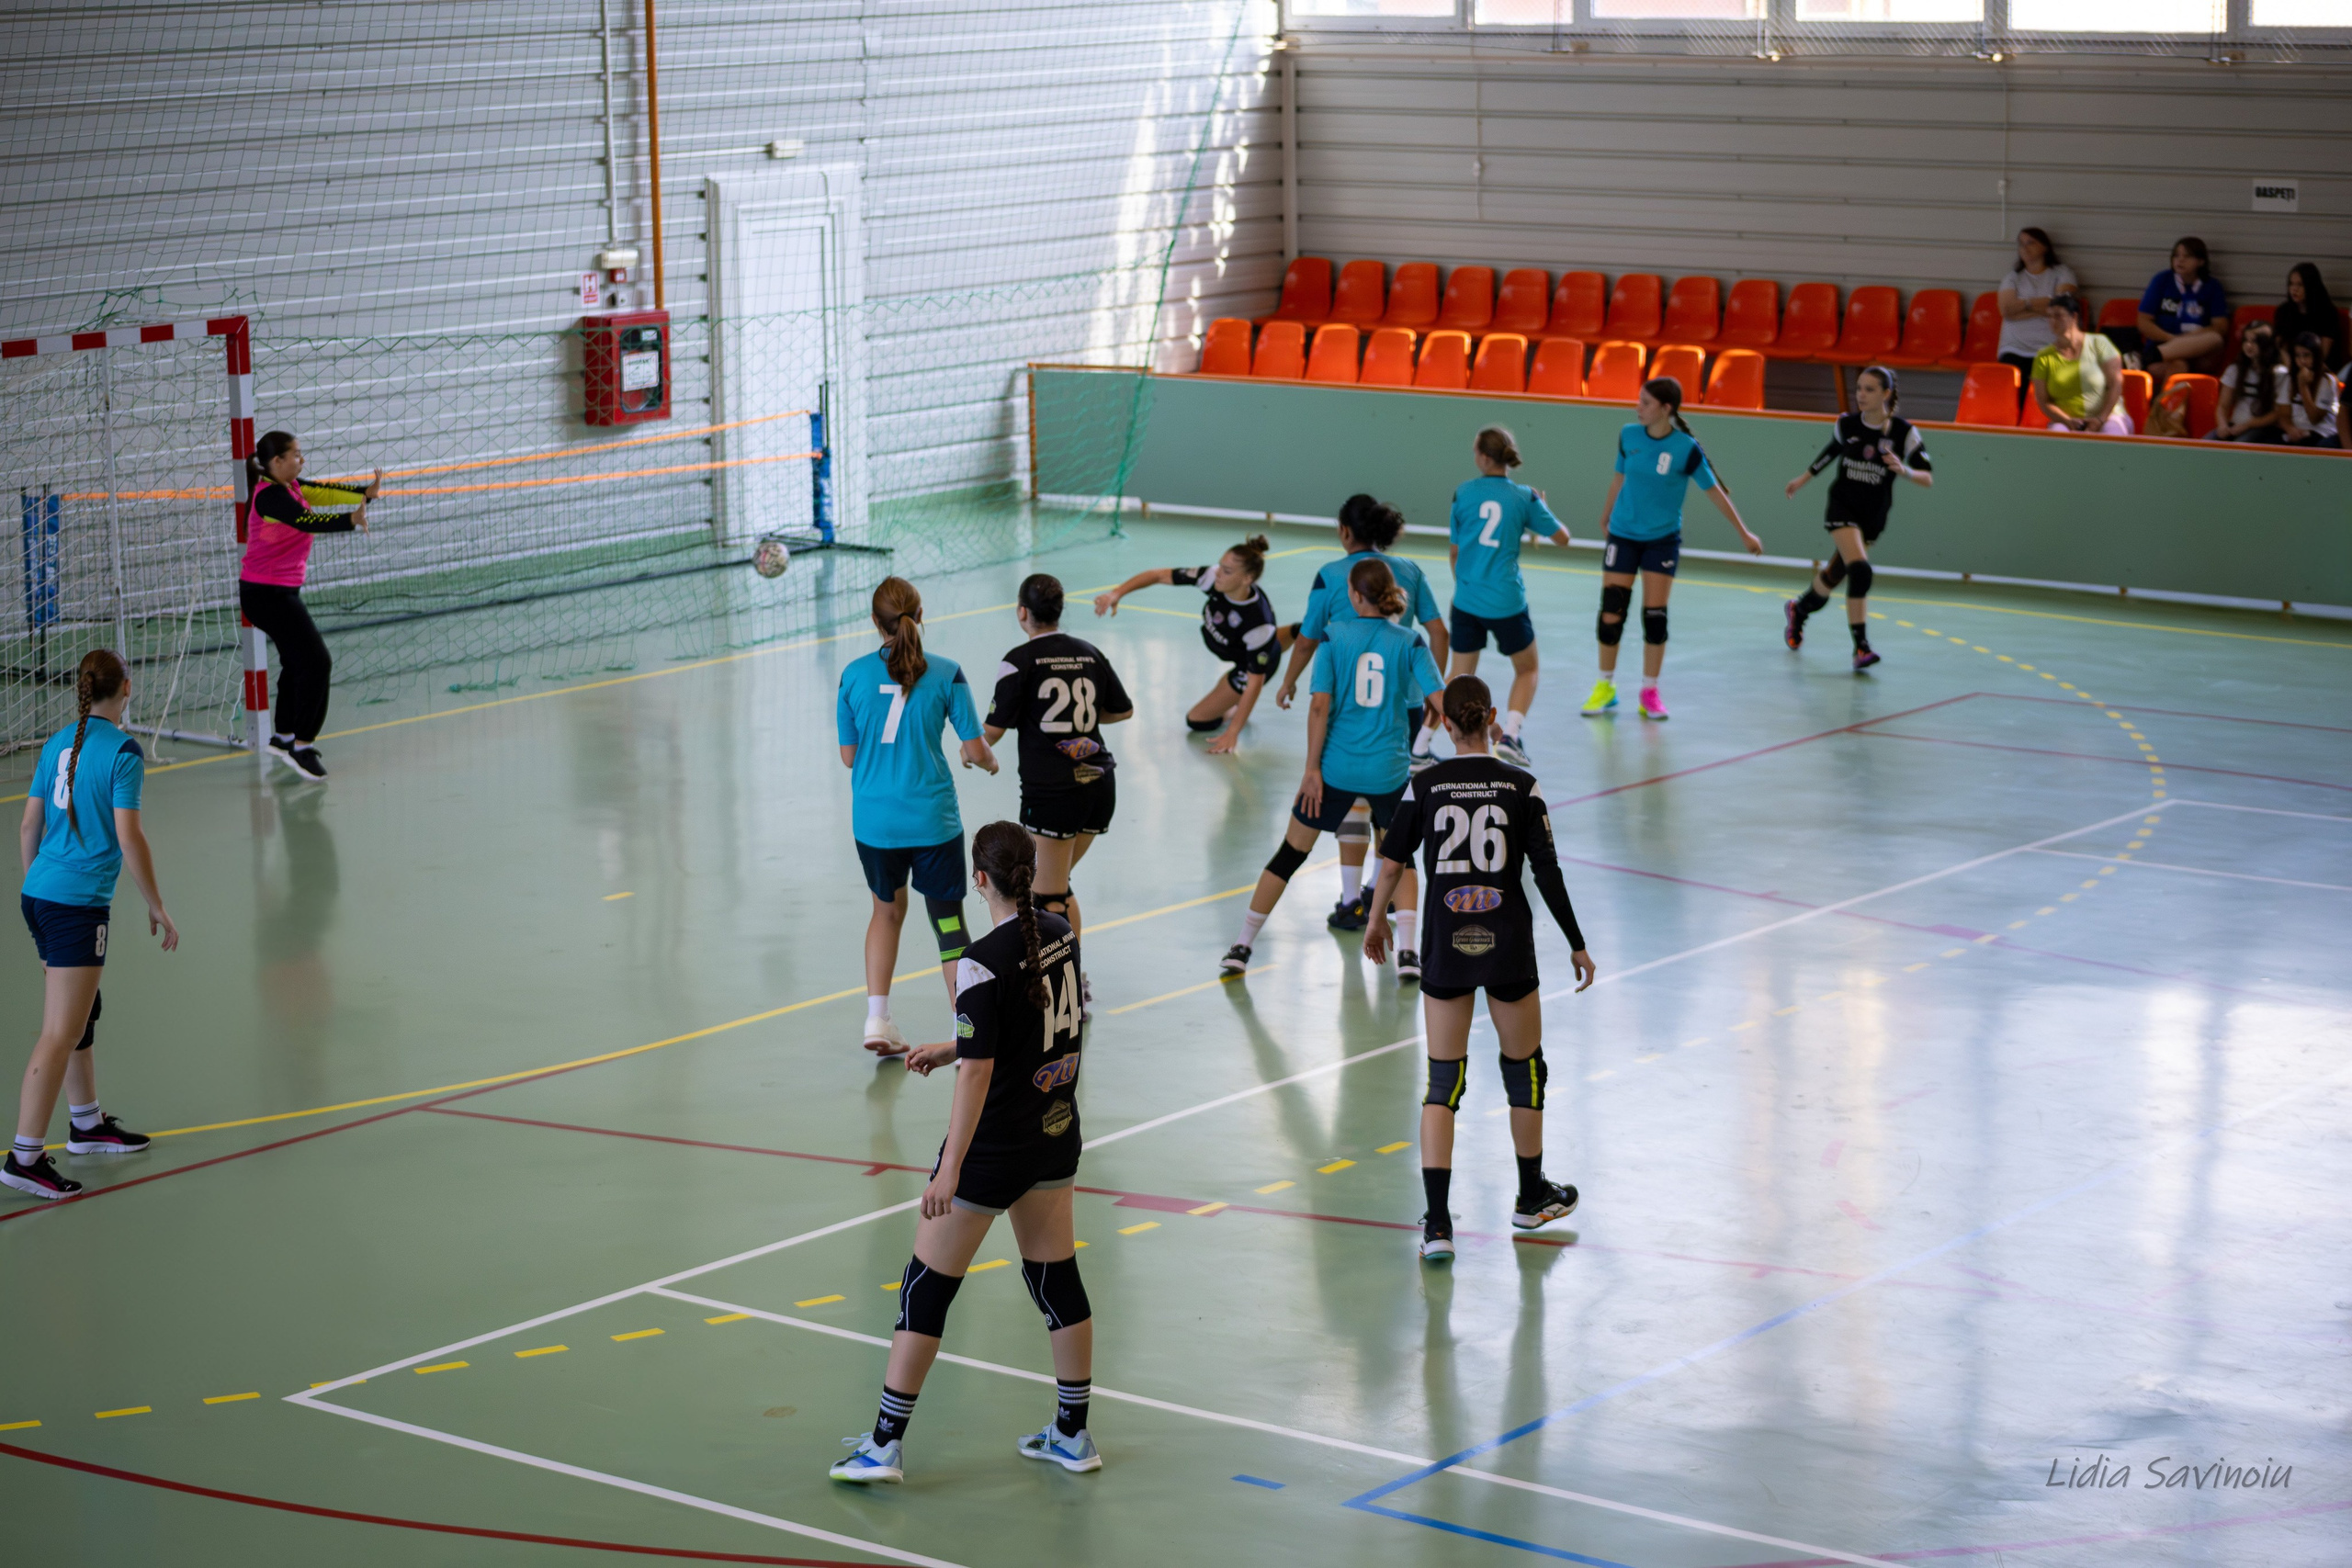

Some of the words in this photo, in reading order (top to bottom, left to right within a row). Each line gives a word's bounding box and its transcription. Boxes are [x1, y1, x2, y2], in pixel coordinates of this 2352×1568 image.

[1478, 500, 1503, 548] 2
[1604, 543, 1619, 568] 9
[1037, 677, 1097, 733] 28
[1354, 651, 1385, 708] 6
[878, 683, 909, 745] 7
[53, 747, 80, 810] 8
[1430, 781, 1489, 794] INTERNATIONAL
[1490, 780, 1517, 792] NIVAFIL
[1450, 790, 1498, 799] CONSTRUCT
[1433, 804, 1510, 875] 26
[95, 923, 107, 958] 8
[1039, 943, 1072, 969] CONSTRUCT
[1041, 959, 1082, 1054] 14
